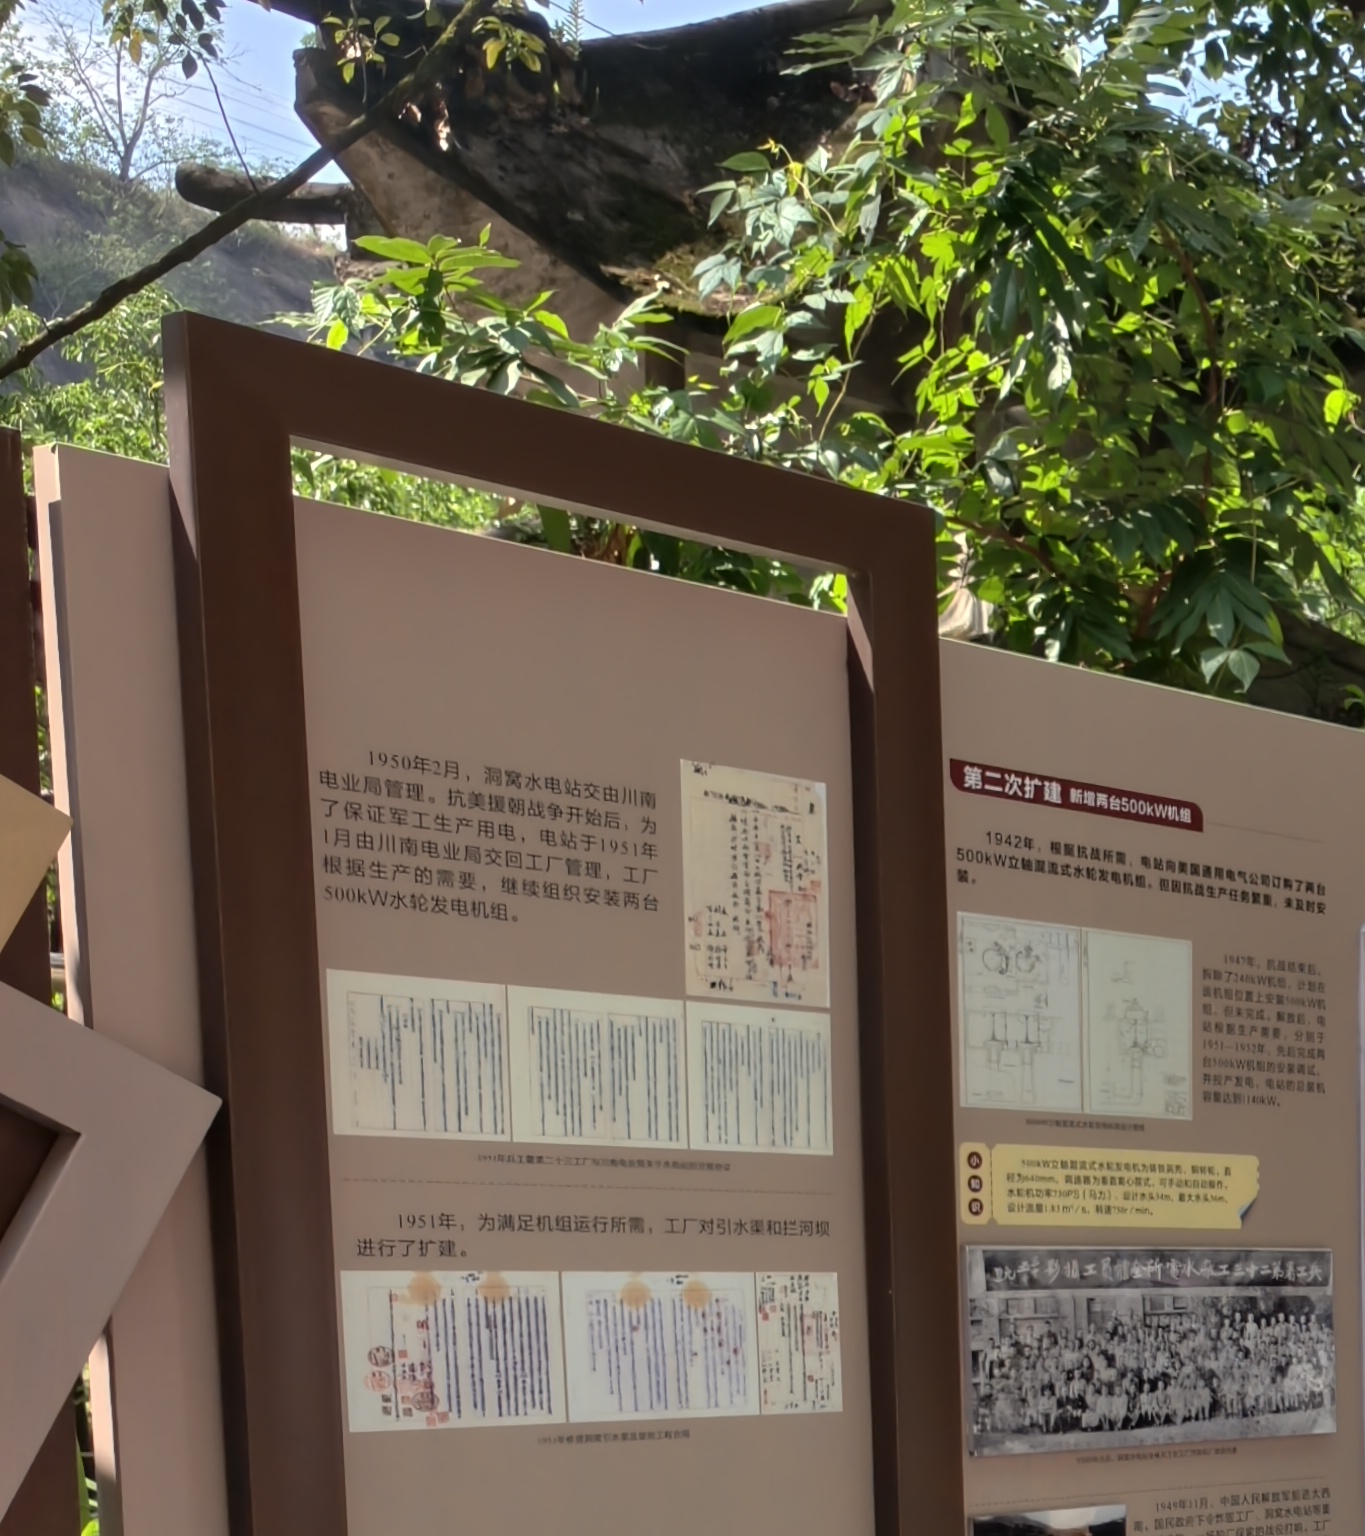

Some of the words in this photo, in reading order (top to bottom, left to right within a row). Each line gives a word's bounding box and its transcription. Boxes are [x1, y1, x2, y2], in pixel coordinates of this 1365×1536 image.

[320, 770, 656, 834] 电业局管理。抗美援朝战争开始后，为
[369, 751, 656, 809] 1950年2月，洞窝水电站交由川南
[963, 765, 1062, 804] 第二次扩建
[1069, 787, 1192, 824] 新增两台500kW机组
[320, 798, 658, 859] 了保证军工生产用电，电站于1951年
[324, 829, 658, 884] 1月由川南电业局交回工厂管理，工厂
[323, 854, 658, 911] 根据生产的需要，继续组织安装两台
[324, 886, 518, 922] 500kW水轮发电机组。
[356, 1238, 467, 1258] 进行了扩建。
[398, 1213, 830, 1237] 1951年，为满足机组运行所需，工厂对引水渠和拦河坝
